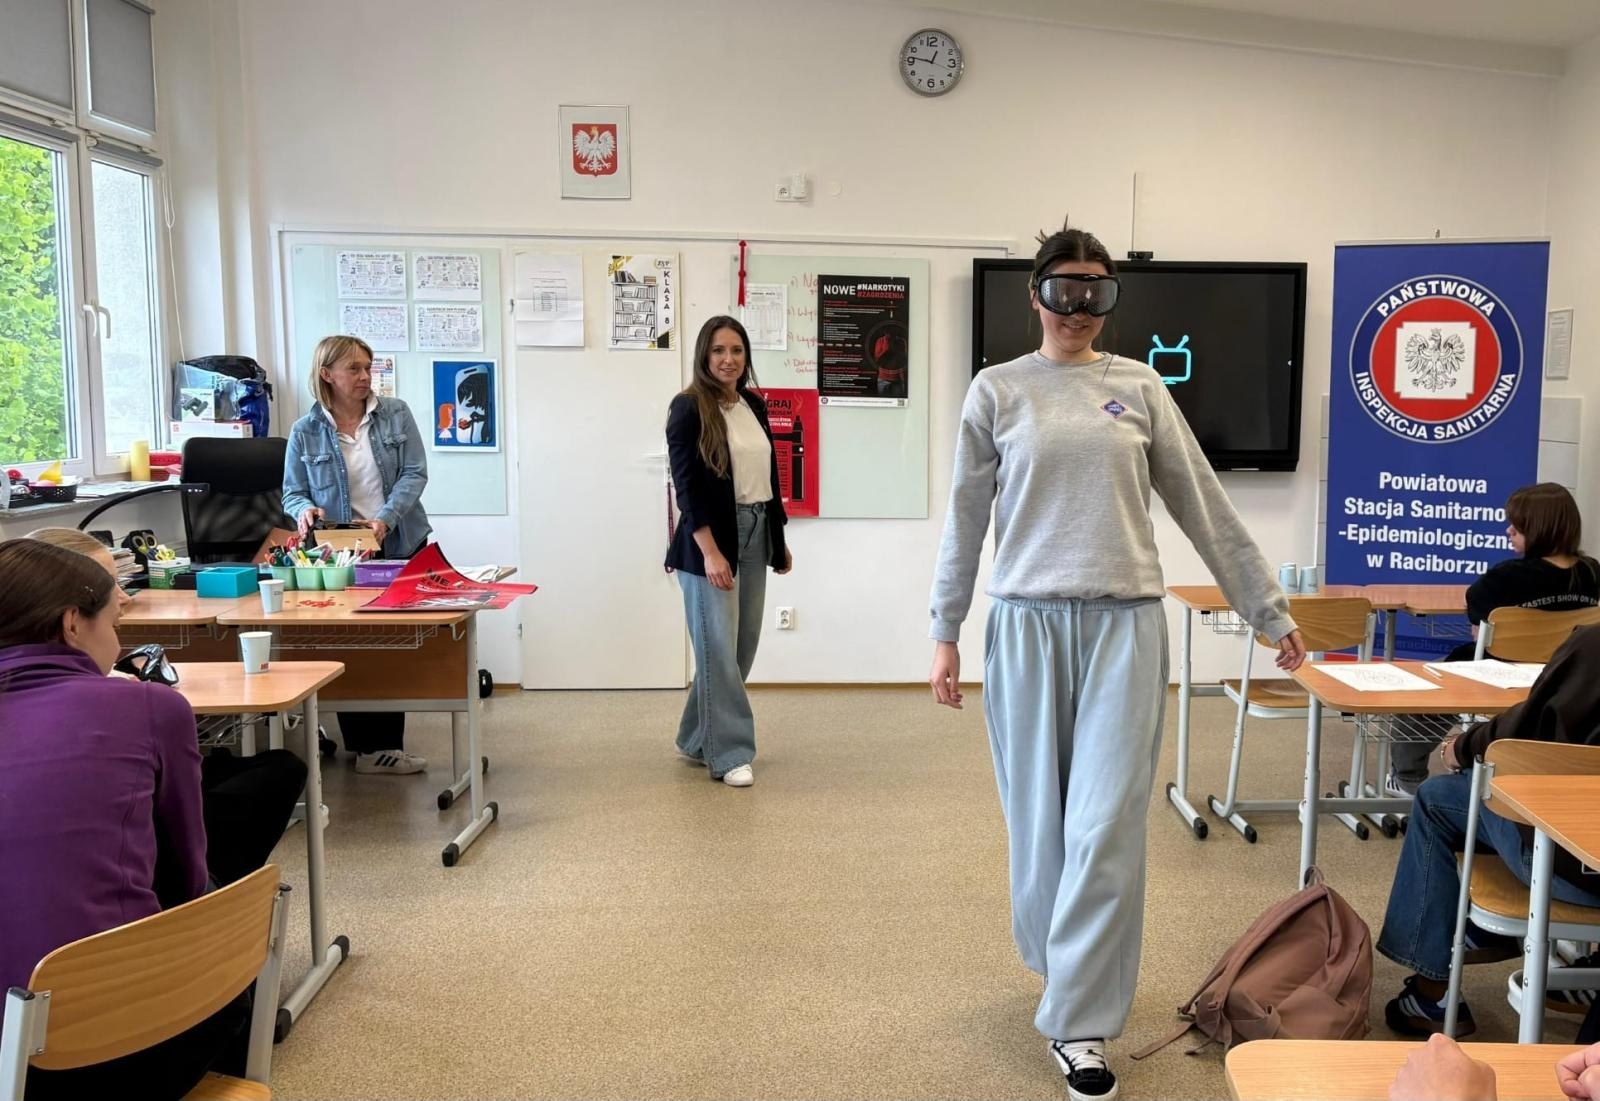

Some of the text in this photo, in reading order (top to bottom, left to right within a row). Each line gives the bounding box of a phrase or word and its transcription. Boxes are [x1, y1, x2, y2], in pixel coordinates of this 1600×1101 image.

[926, 36, 938, 47] 12
[907, 56, 915, 66] 9
[947, 58, 956, 68] 3
[927, 78, 935, 88] 6
[823, 284, 856, 295] NOWE
[856, 283, 905, 292] #NARKOTYKI
[1376, 280, 1496, 317] PAŃSTWOWA
[1355, 371, 1516, 439] INSPEKCJA SANITARNA
[1379, 471, 1487, 494] Powiatowa
[1344, 497, 1506, 522] Stacja Sanitarno
[1366, 551, 1488, 575] w Raciborzu
[1557, 593, 1579, 602] SHOW
